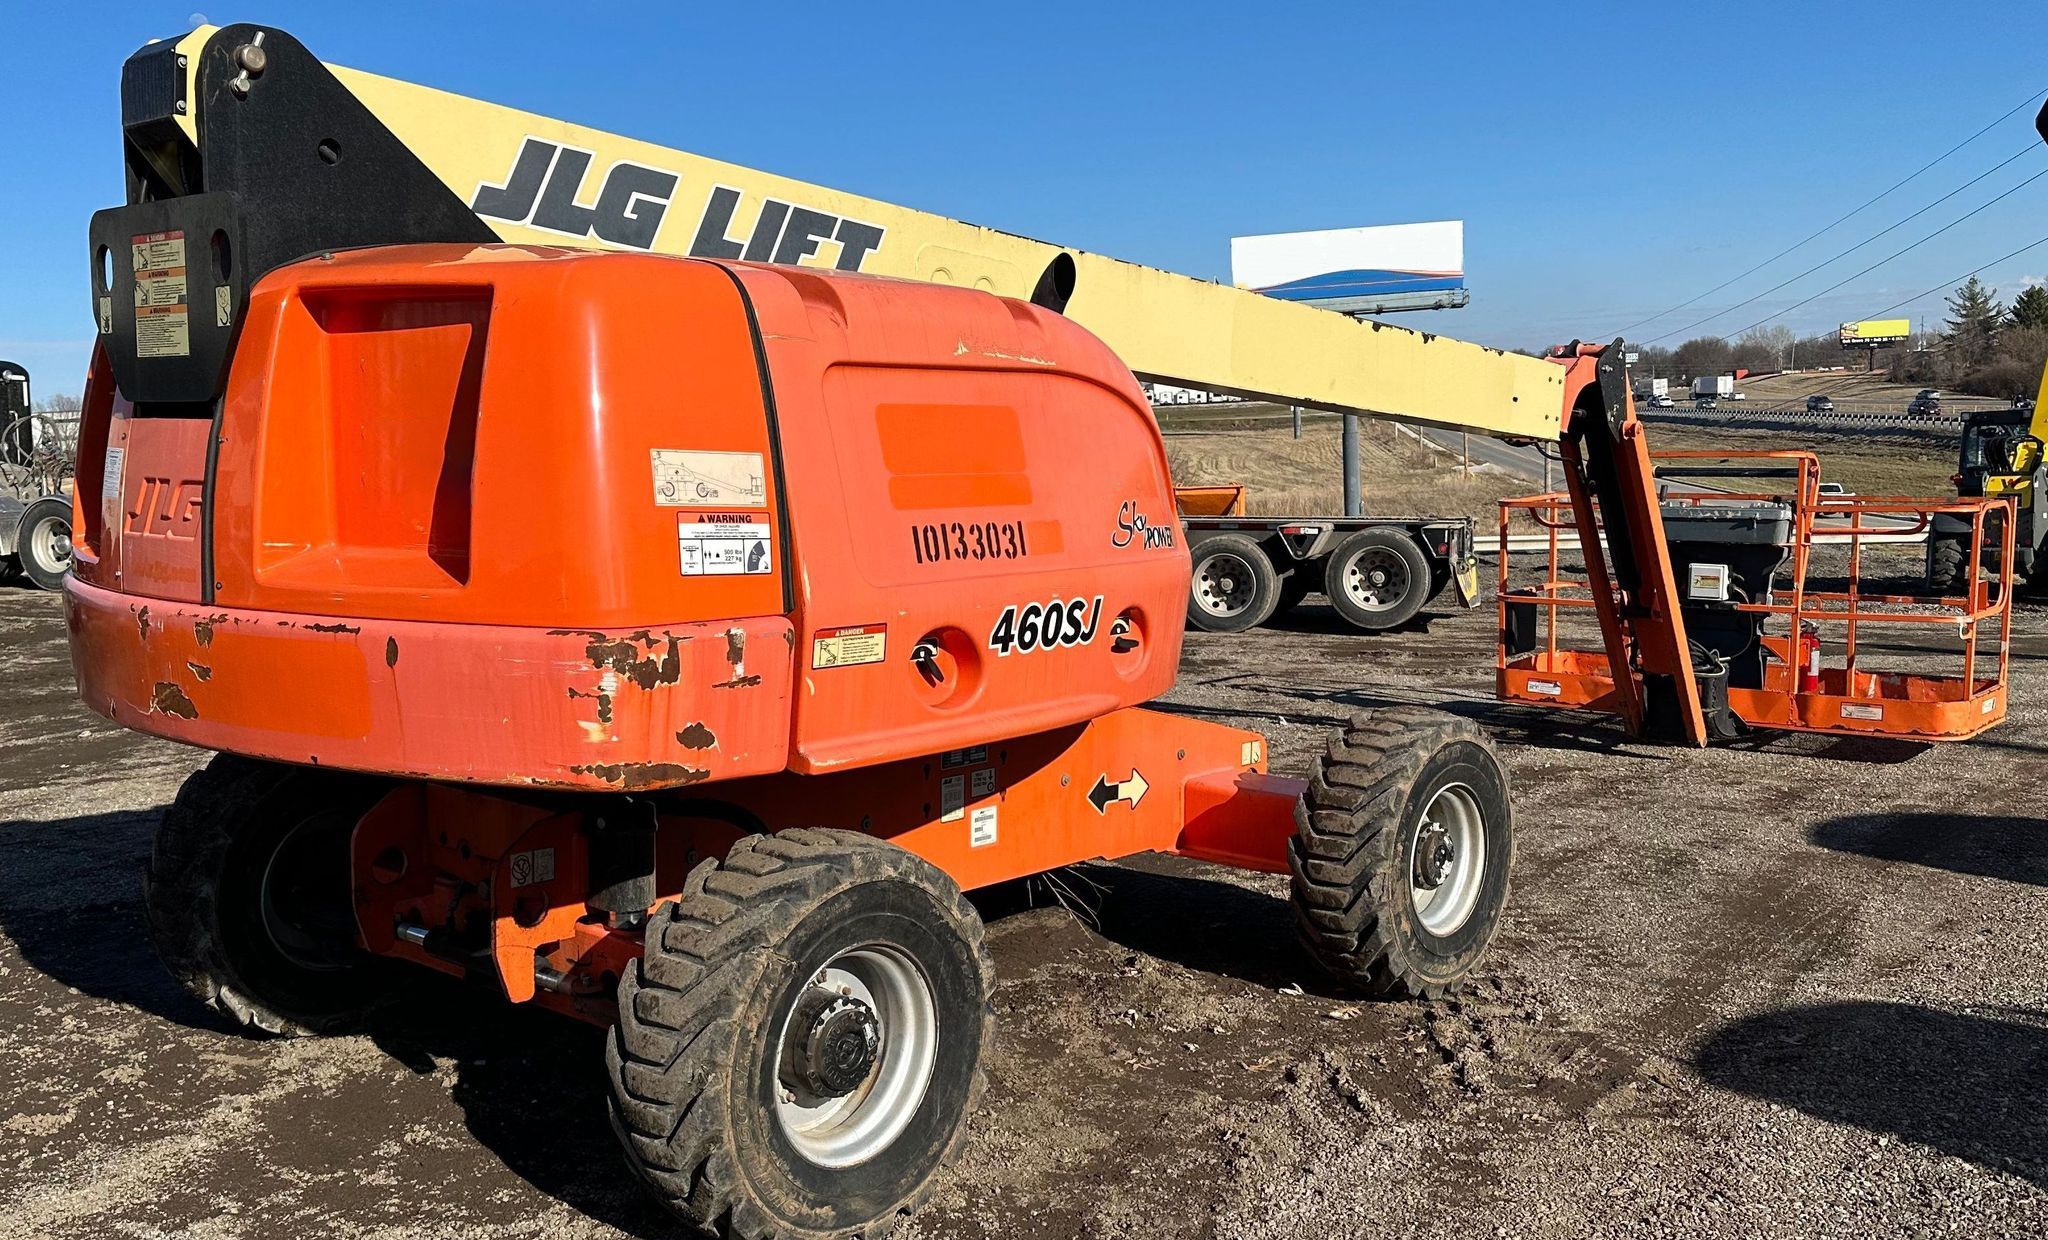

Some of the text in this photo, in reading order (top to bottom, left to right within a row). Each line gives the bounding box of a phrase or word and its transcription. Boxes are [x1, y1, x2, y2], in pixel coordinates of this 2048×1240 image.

[471, 134, 888, 273] JLG LIFT
[123, 477, 203, 541] JLG
[707, 514, 752, 524] WARNING
[1111, 499, 1175, 550] Sky POWER
[912, 520, 1027, 564] 10133031
[840, 628, 865, 637] DANGER
[989, 594, 1104, 657] 460SJ
